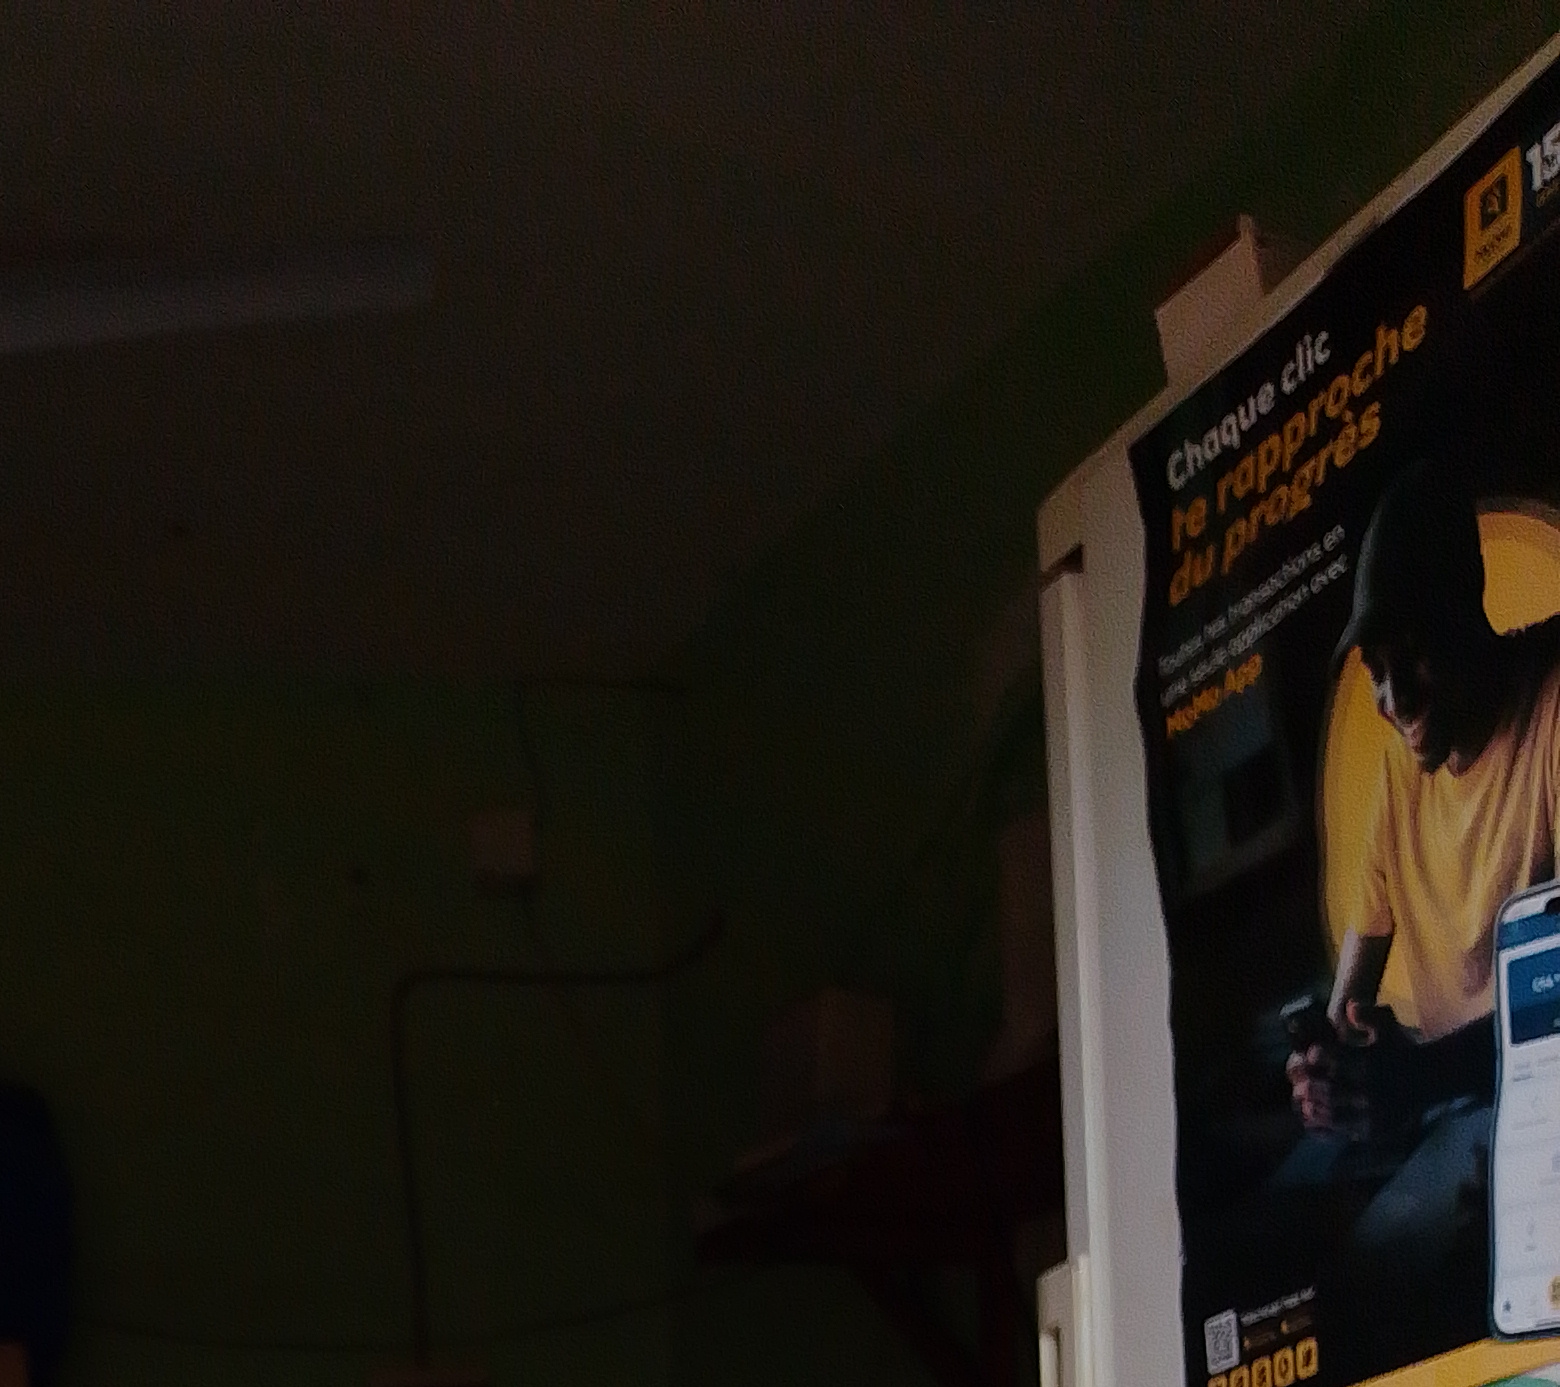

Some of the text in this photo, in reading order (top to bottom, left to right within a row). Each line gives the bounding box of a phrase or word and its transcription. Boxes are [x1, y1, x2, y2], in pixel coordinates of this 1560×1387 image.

[1166, 331, 1331, 491] Chaque clic
[1168, 401, 1381, 607] du progrès
[1171, 305, 1427, 552] te rapproche
